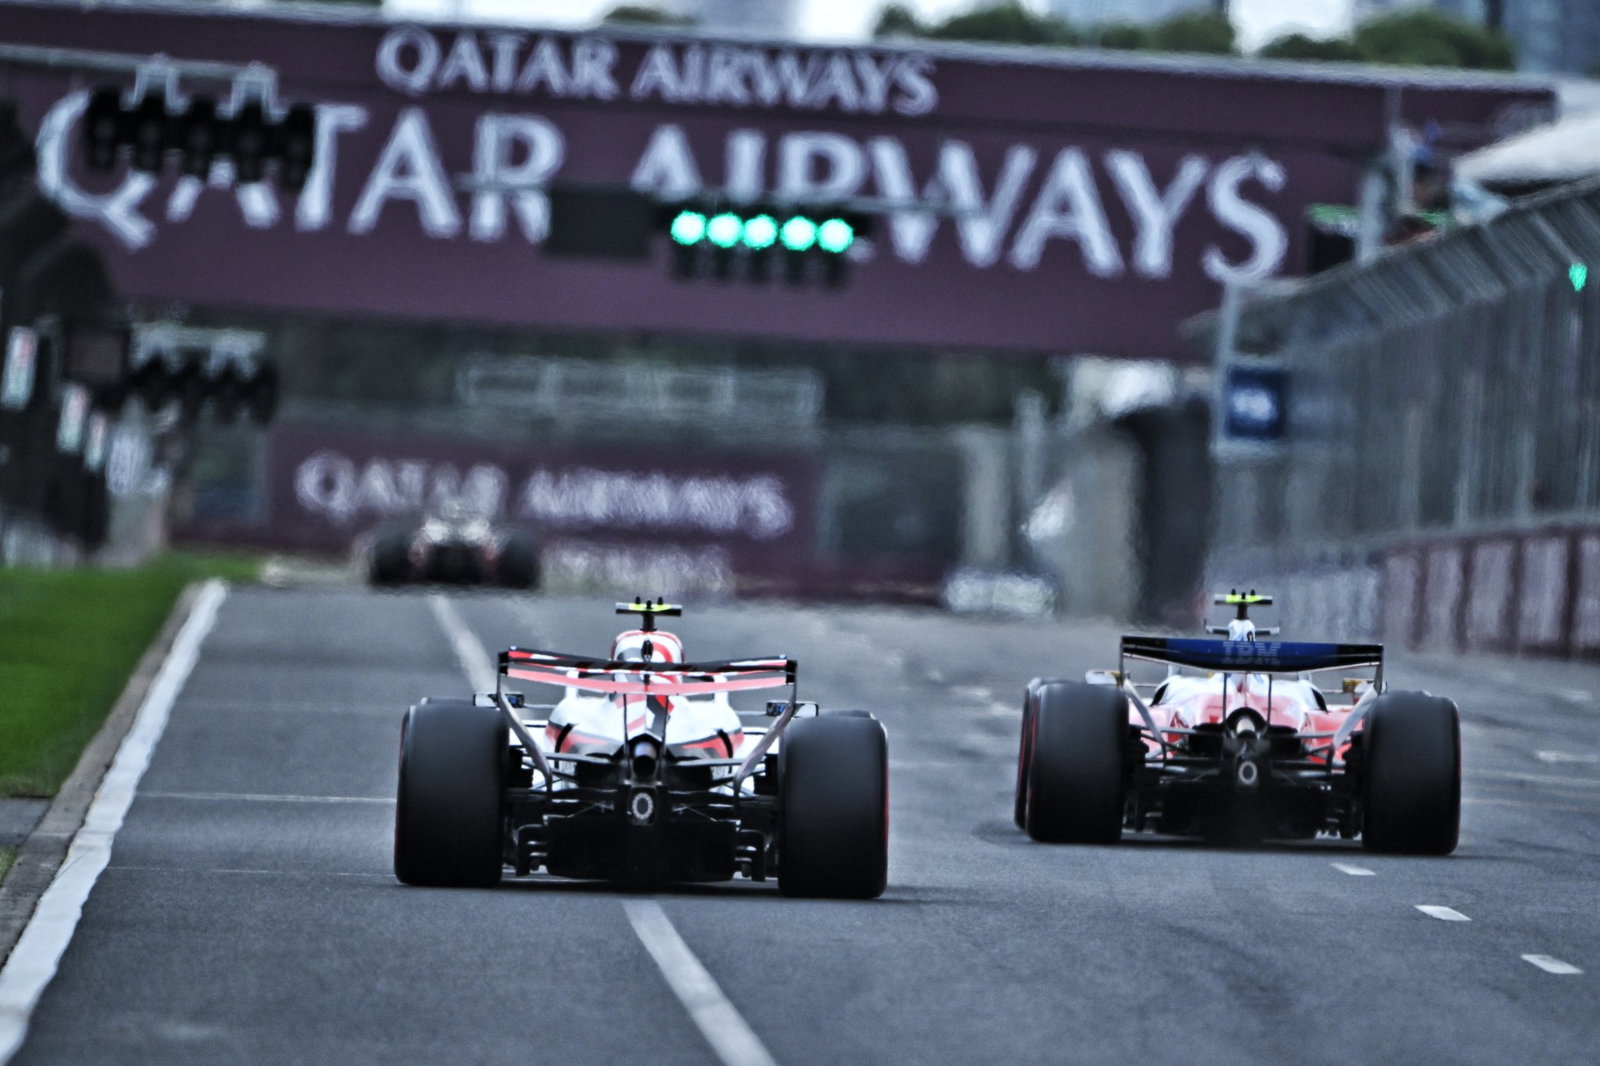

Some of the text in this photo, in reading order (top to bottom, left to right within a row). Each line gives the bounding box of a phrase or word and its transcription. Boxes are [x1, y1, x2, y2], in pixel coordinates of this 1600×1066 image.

[376, 28, 938, 116] QATAR AIRWAYS
[1222, 641, 1281, 664] IBM
